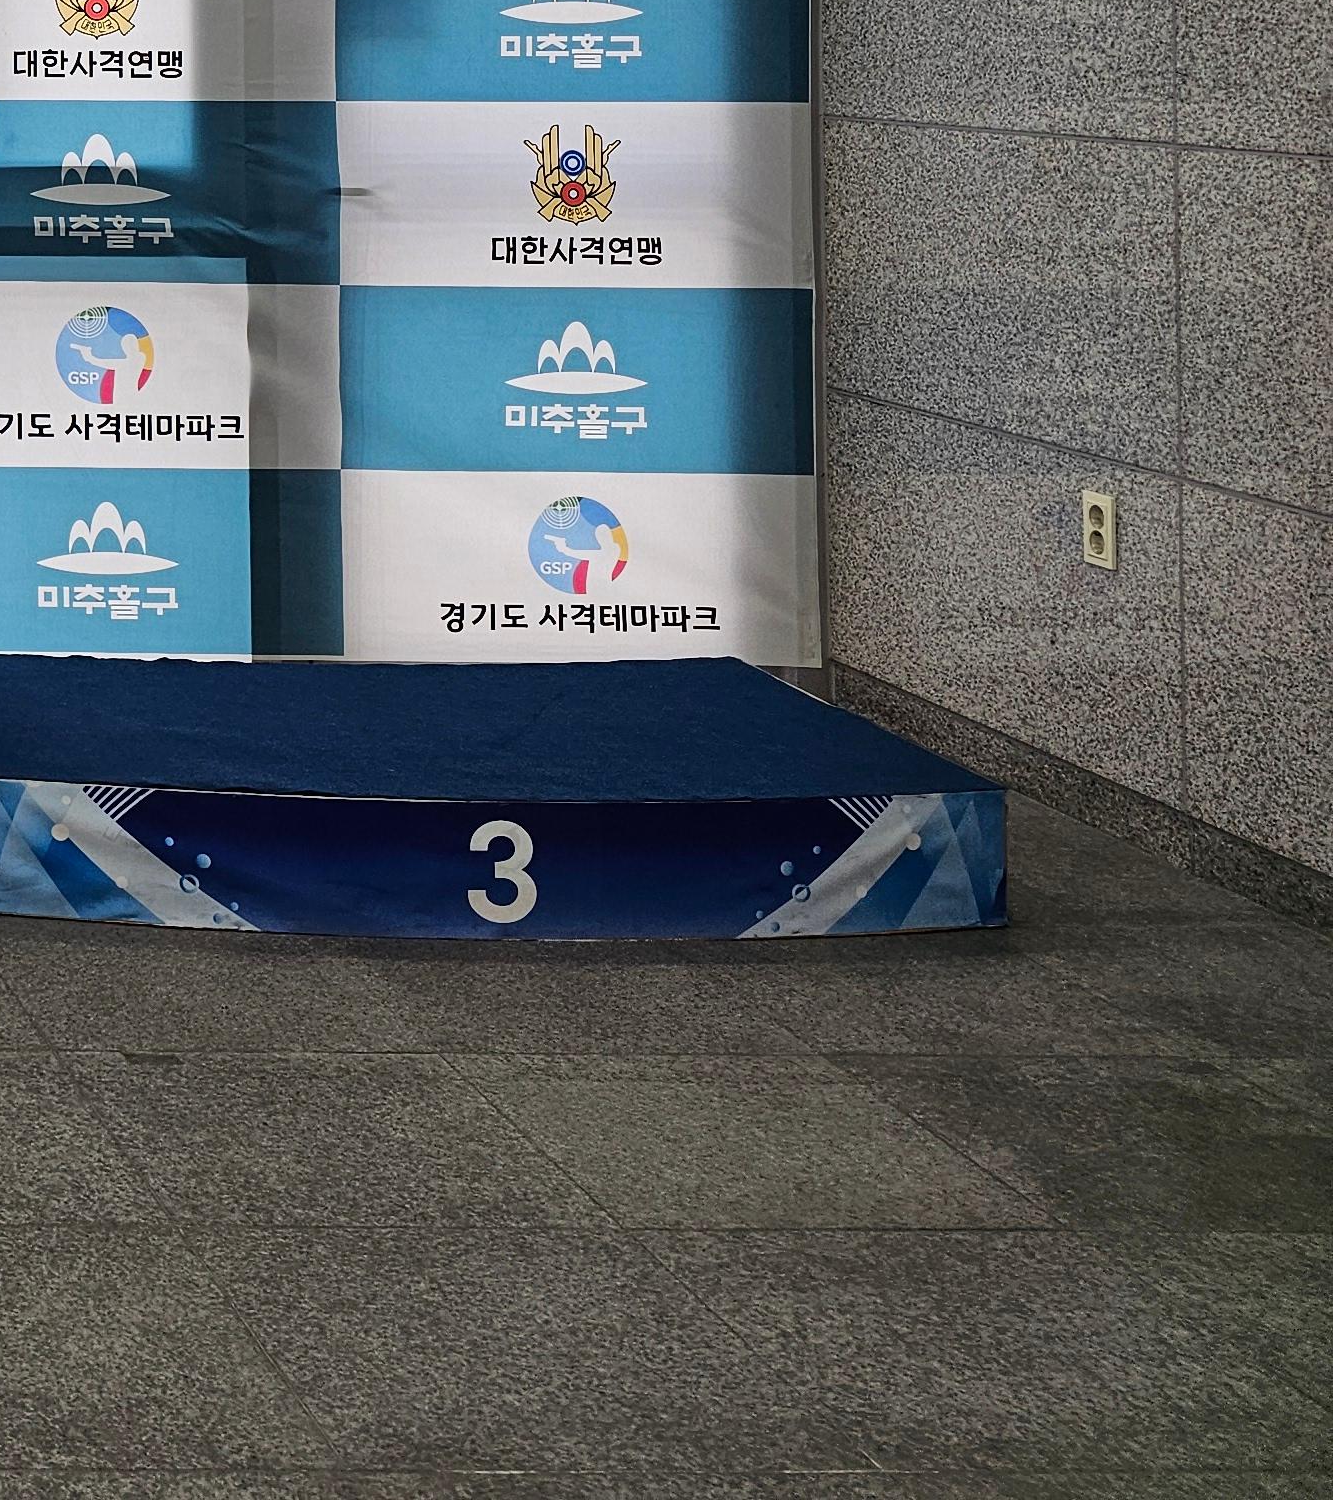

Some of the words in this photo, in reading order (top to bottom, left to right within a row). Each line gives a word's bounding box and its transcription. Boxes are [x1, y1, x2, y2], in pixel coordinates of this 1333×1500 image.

[81, 19, 115, 31] 대한민국
[14, 49, 182, 78] 대한사격연맹
[501, 34, 642, 68] 미추홀구
[559, 206, 591, 219] 대한민국
[34, 215, 173, 248] 미추홀구
[492, 236, 661, 265] 대한사격연맹
[68, 371, 100, 385] GSP
[65, 414, 244, 442] 사격테마파크
[506, 404, 647, 439] 미추홀구
[540, 561, 572, 574] GSP
[38, 584, 178, 619] 미추홀구
[441, 603, 528, 632] 경기도
[539, 604, 720, 633] 사격테마파크
[468, 820, 537, 923] 3
